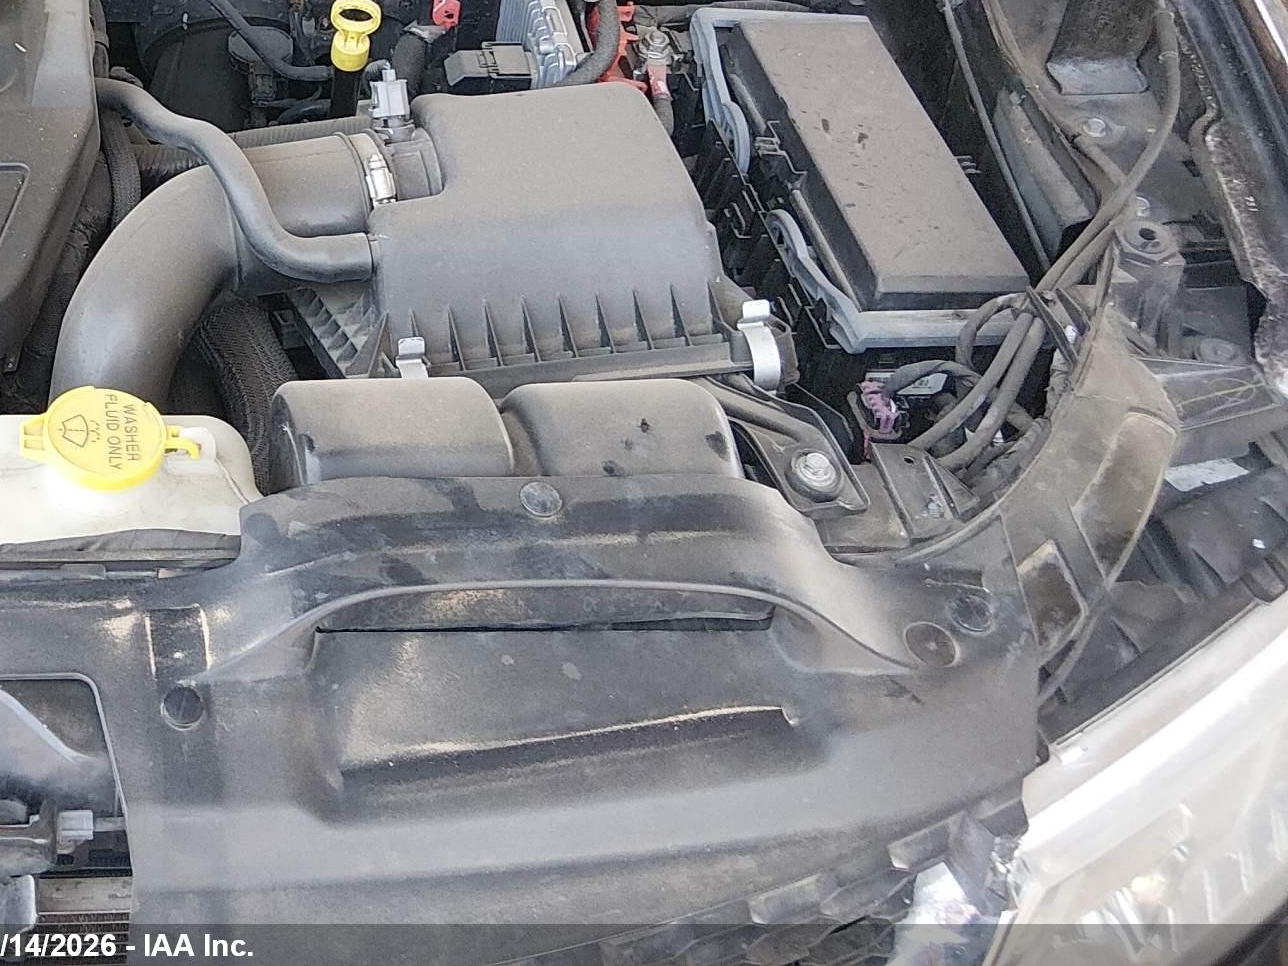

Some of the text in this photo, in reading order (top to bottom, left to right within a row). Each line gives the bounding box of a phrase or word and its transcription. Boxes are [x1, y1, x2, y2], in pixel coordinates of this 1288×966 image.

[104, 393, 123, 471] FLUID ONLY
[123, 403, 141, 462] WASHER
